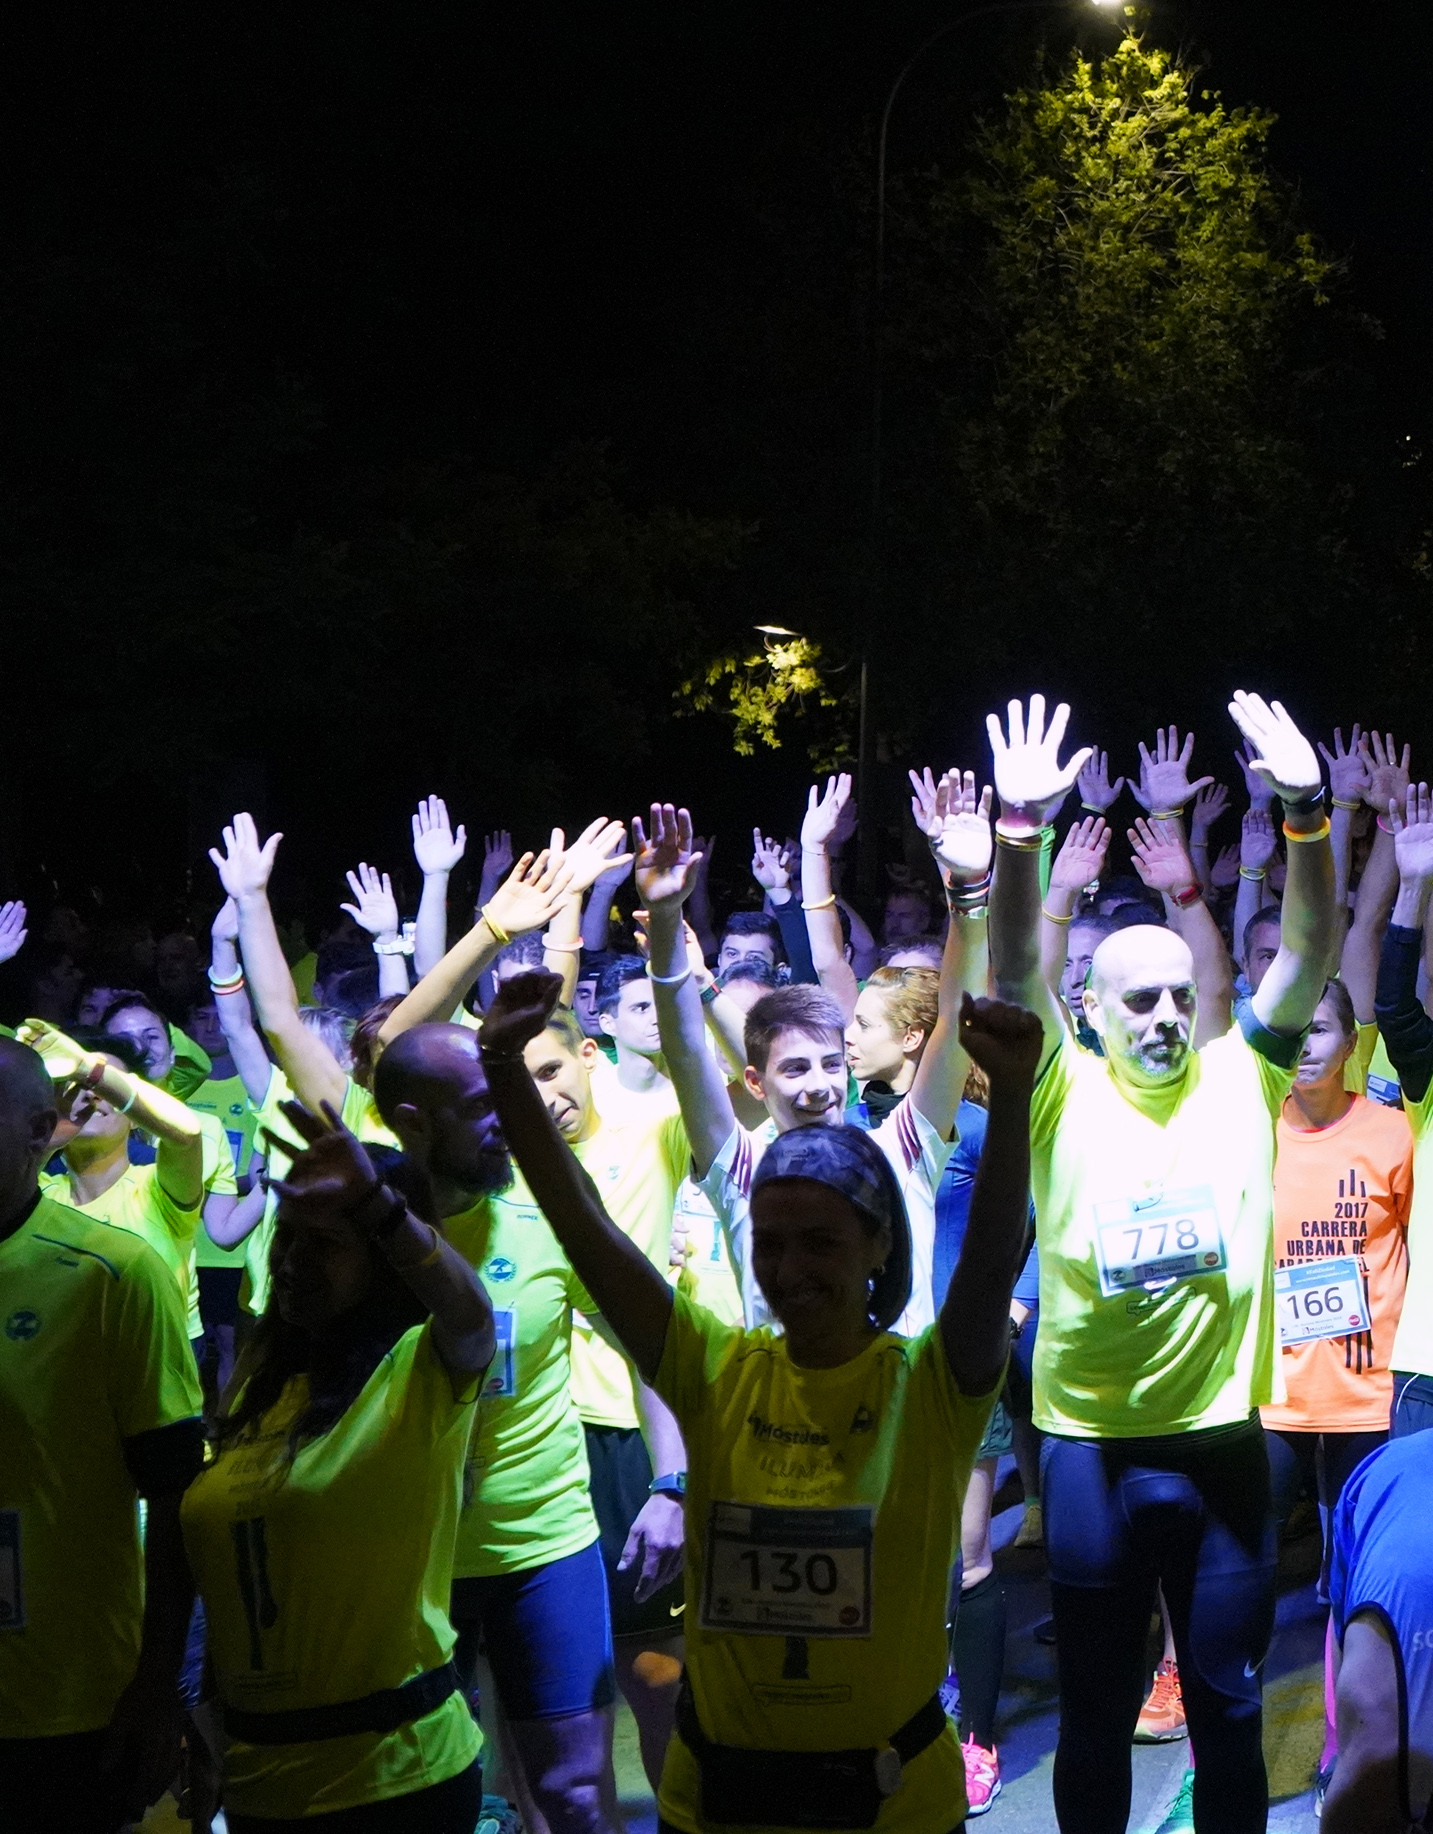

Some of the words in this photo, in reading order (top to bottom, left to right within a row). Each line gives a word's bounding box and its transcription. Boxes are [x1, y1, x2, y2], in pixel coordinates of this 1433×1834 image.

[1334, 1202, 1368, 1218] 2017
[1122, 1219, 1199, 1260] 778
[1301, 1220, 1368, 1238] CARRERA
[1286, 1239, 1346, 1256] URBANA
[1352, 1239, 1366, 1254] DE
[1287, 1286, 1344, 1320] 166
[739, 1551, 838, 1596] 130
